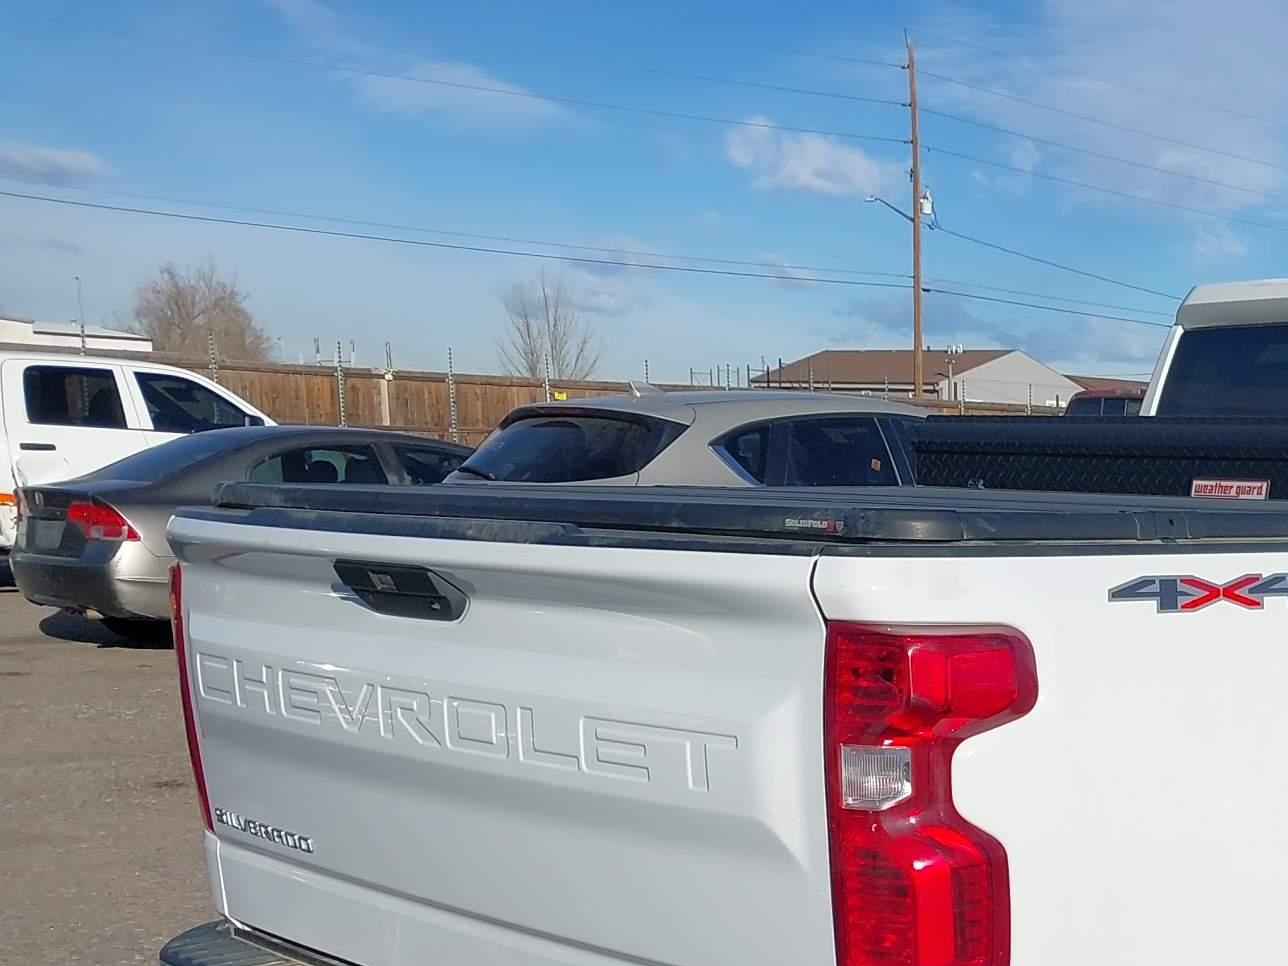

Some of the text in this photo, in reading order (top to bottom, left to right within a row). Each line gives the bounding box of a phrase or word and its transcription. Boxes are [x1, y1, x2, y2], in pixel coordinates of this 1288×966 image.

[1194, 484, 1263, 497] weather guard
[197, 653, 737, 791] CHEVROLET
[214, 807, 314, 853] SILVERADO
